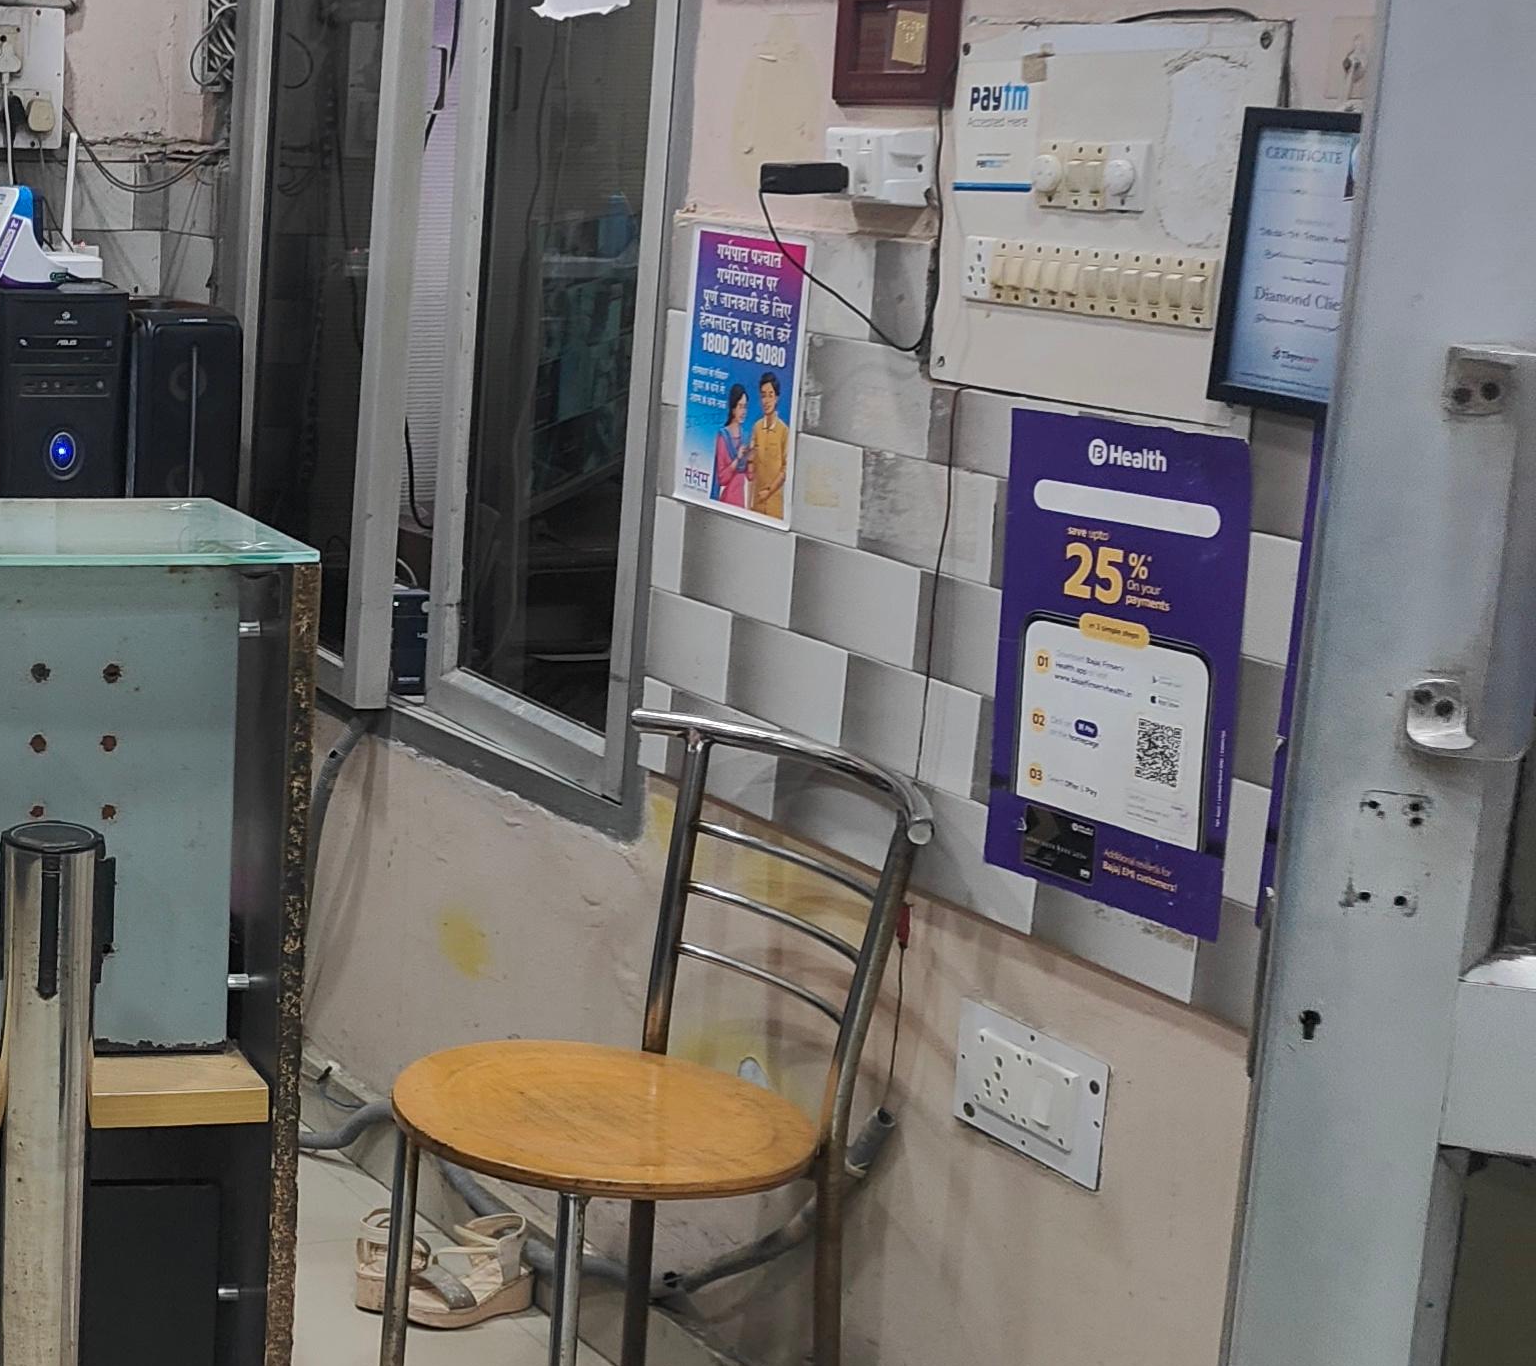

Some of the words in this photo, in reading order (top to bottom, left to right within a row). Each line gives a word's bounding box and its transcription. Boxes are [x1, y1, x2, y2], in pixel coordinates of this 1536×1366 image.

[1265, 146, 1343, 165] CERTIFICATE
[716, 239, 751, 263] गर्भपात
[766, 276, 780, 292] पर
[1254, 285, 1312, 308] Diamond
[719, 291, 759, 314] जानकारी
[760, 294, 771, 315] के
[772, 296, 793, 322] लिए
[740, 320, 753, 336] पर
[754, 320, 776, 341] कॉल
[701, 331, 729, 356] 1800
[731, 337, 754, 361] 203
[756, 342, 787, 368] 9080
[1108, 444, 1167, 472] Health
[1066, 526, 1087, 538] save
[1063, 541, 1124, 605] 25
[1126, 579, 1140, 591] On
[1140, 584, 1162, 595] your
[1125, 595, 1171, 612] payments
[1037, 655, 1049, 668] 01
[1032, 713, 1045, 726] 02
[1029, 768, 1043, 781] 03
